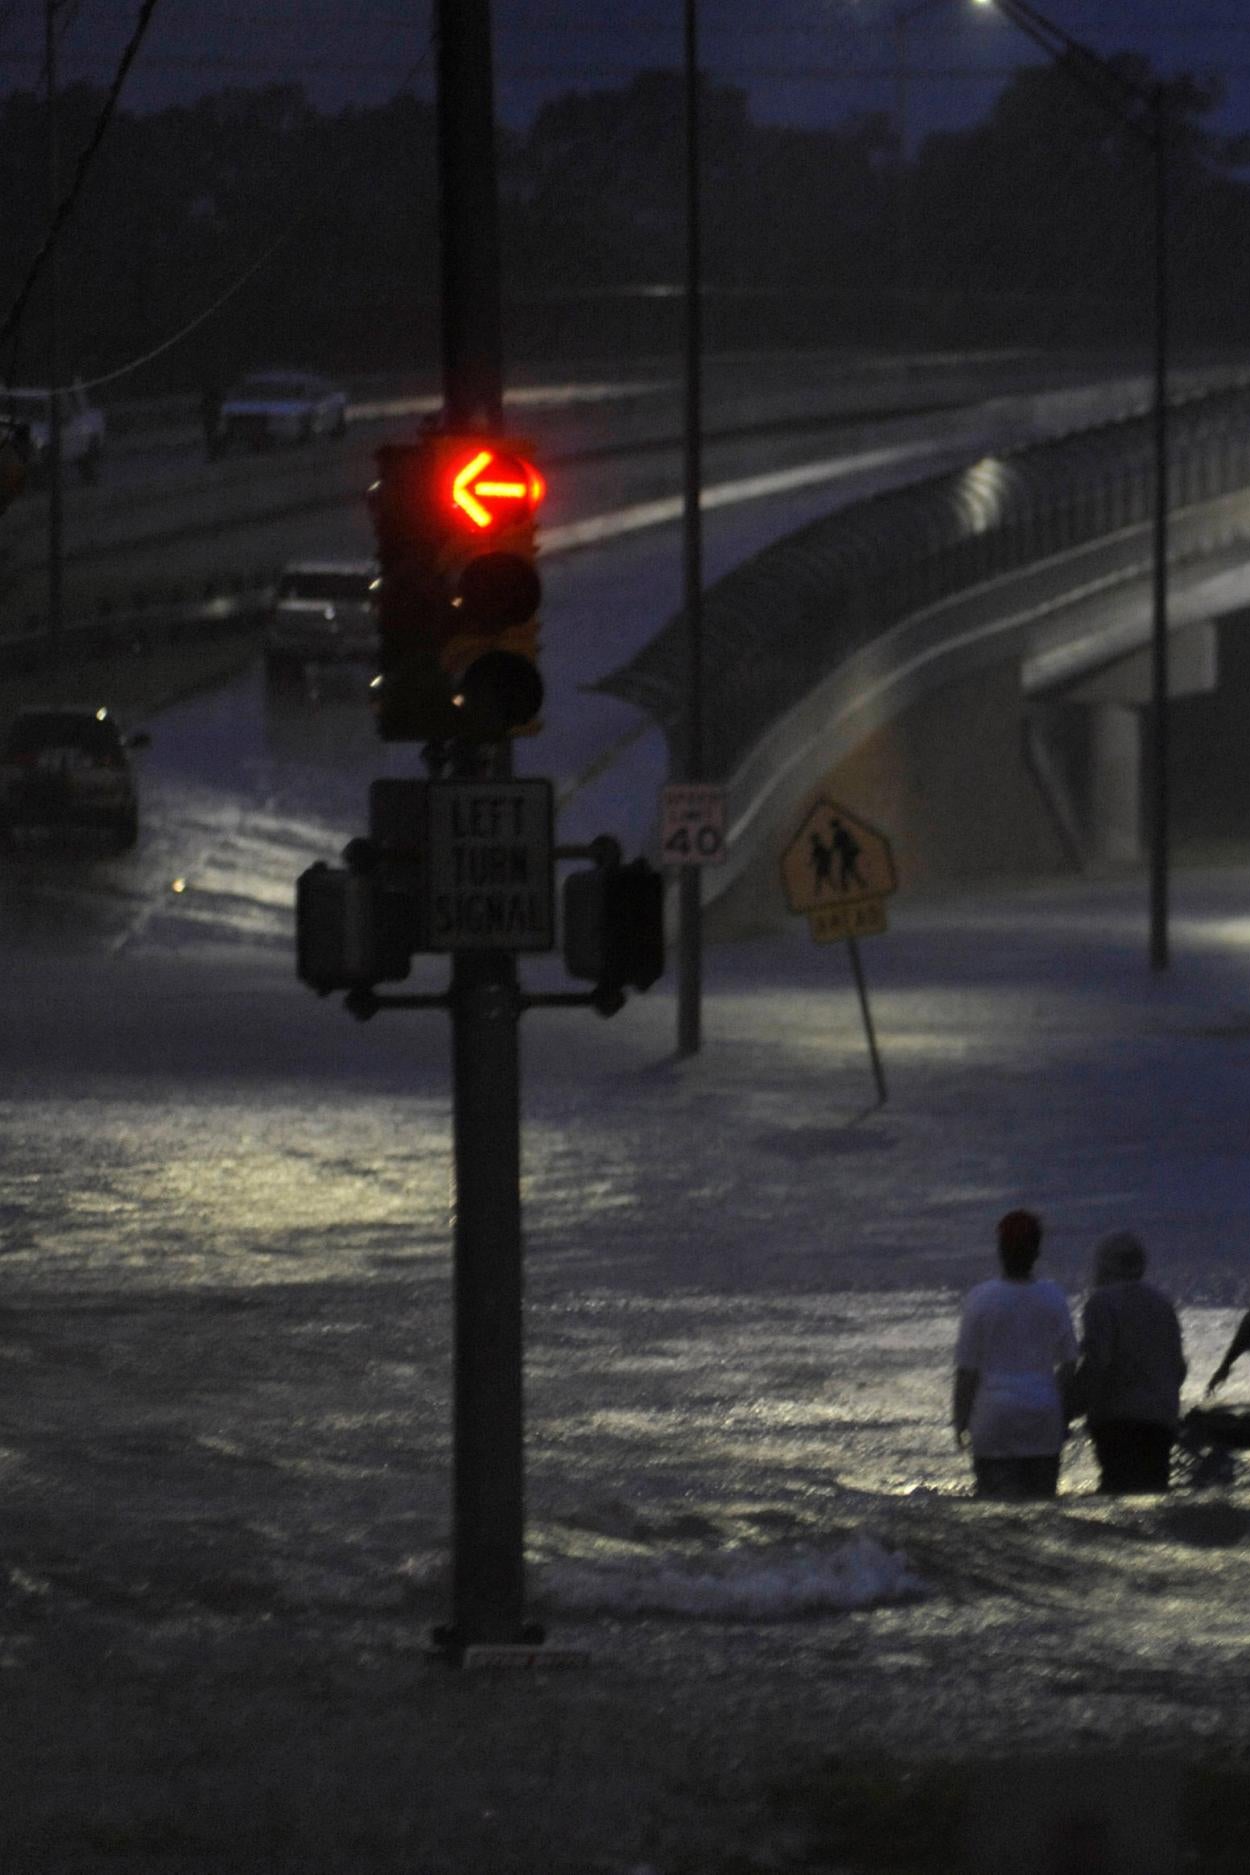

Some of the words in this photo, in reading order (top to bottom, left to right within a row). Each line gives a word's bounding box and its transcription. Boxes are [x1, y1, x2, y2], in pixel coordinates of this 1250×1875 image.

[452, 797, 525, 838] LEFT
[665, 826, 722, 856] 40
[452, 847, 528, 886] TURN
[436, 894, 547, 933] SIGNAL
